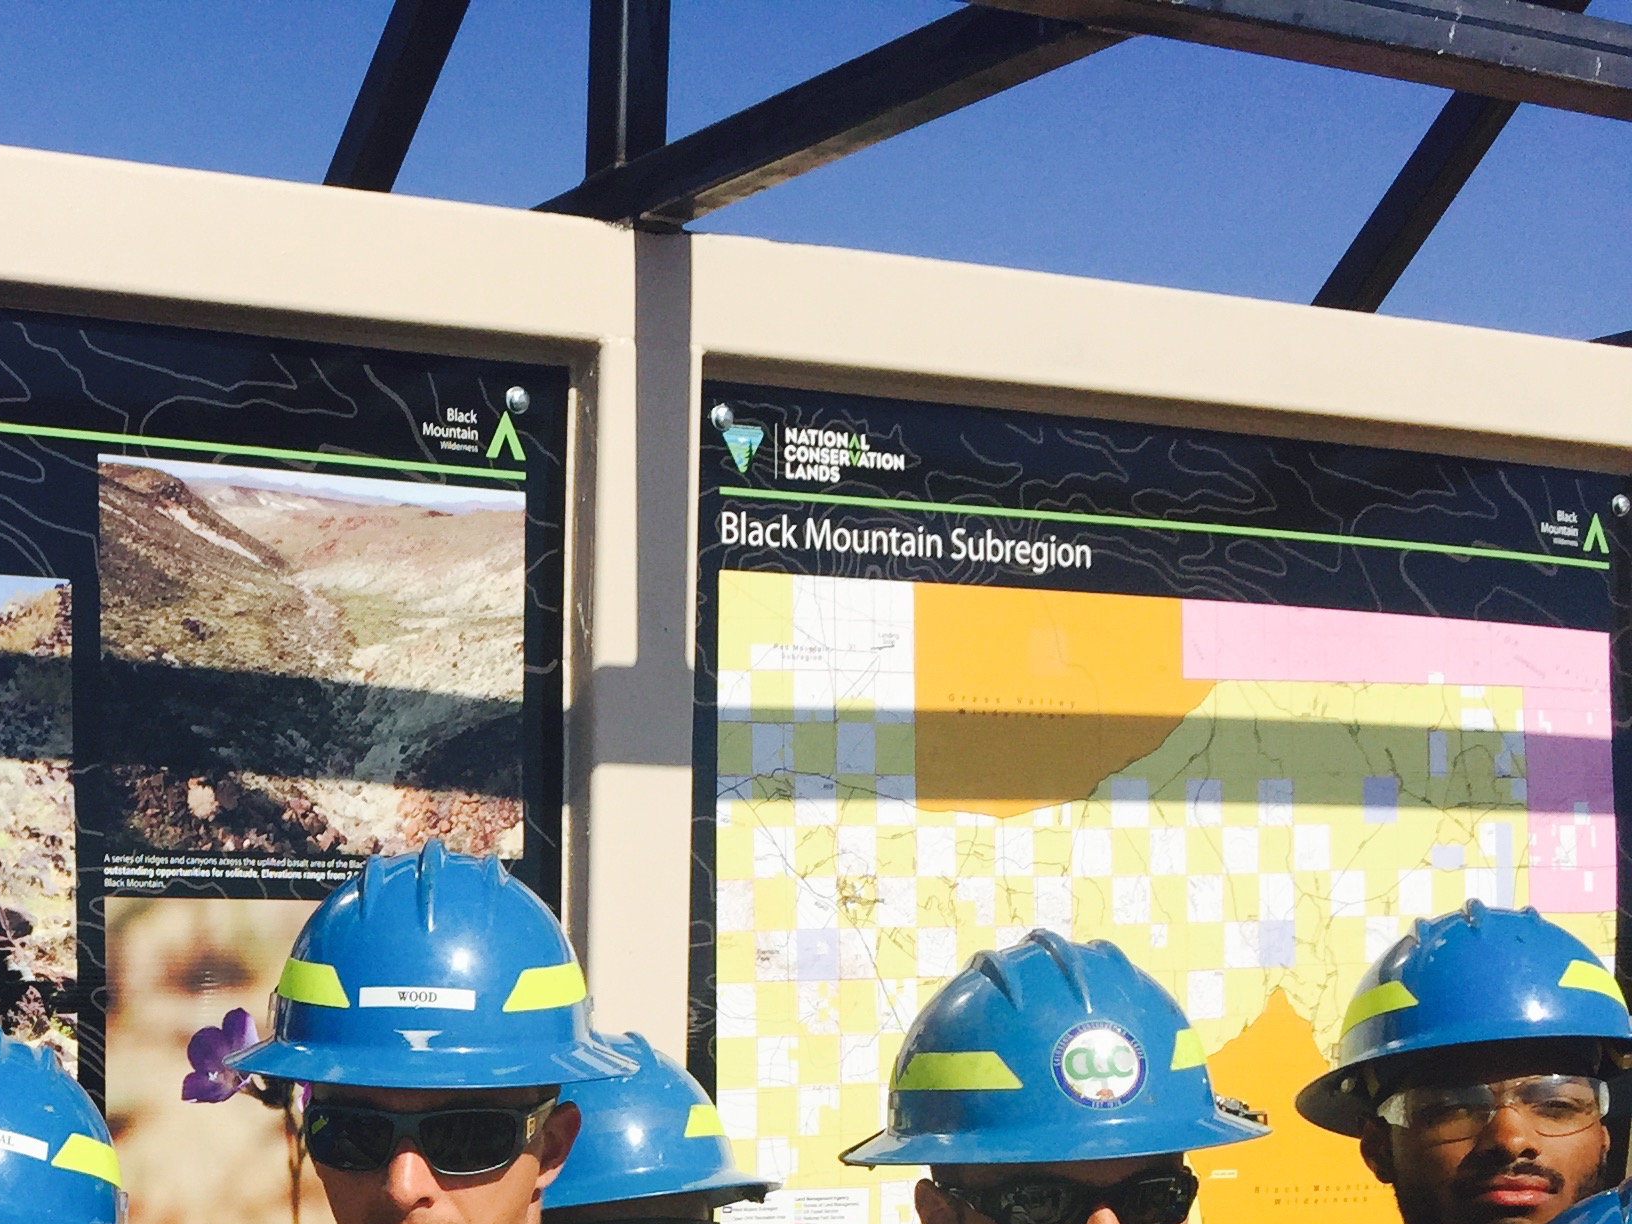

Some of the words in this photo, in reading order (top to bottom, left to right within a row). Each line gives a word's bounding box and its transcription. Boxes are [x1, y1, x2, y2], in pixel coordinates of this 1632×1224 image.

[447, 407, 478, 424] Black
[422, 422, 478, 441] Mountain
[785, 427, 870, 451] NATIONAL
[784, 445, 905, 471] CONSERVATION
[785, 463, 840, 483] LANDS
[720, 511, 798, 549] Black
[806, 518, 943, 559] Mountain
[951, 528, 1092, 573] Subregion
[103, 854, 111, 863] A
[169, 856, 185, 865] and
[103, 866, 155, 878] outstanding
[156, 867, 211, 878] opportunities
[212, 867, 224, 877] for
[103, 878, 125, 888] Black
[398, 990, 438, 1003] WOOD
